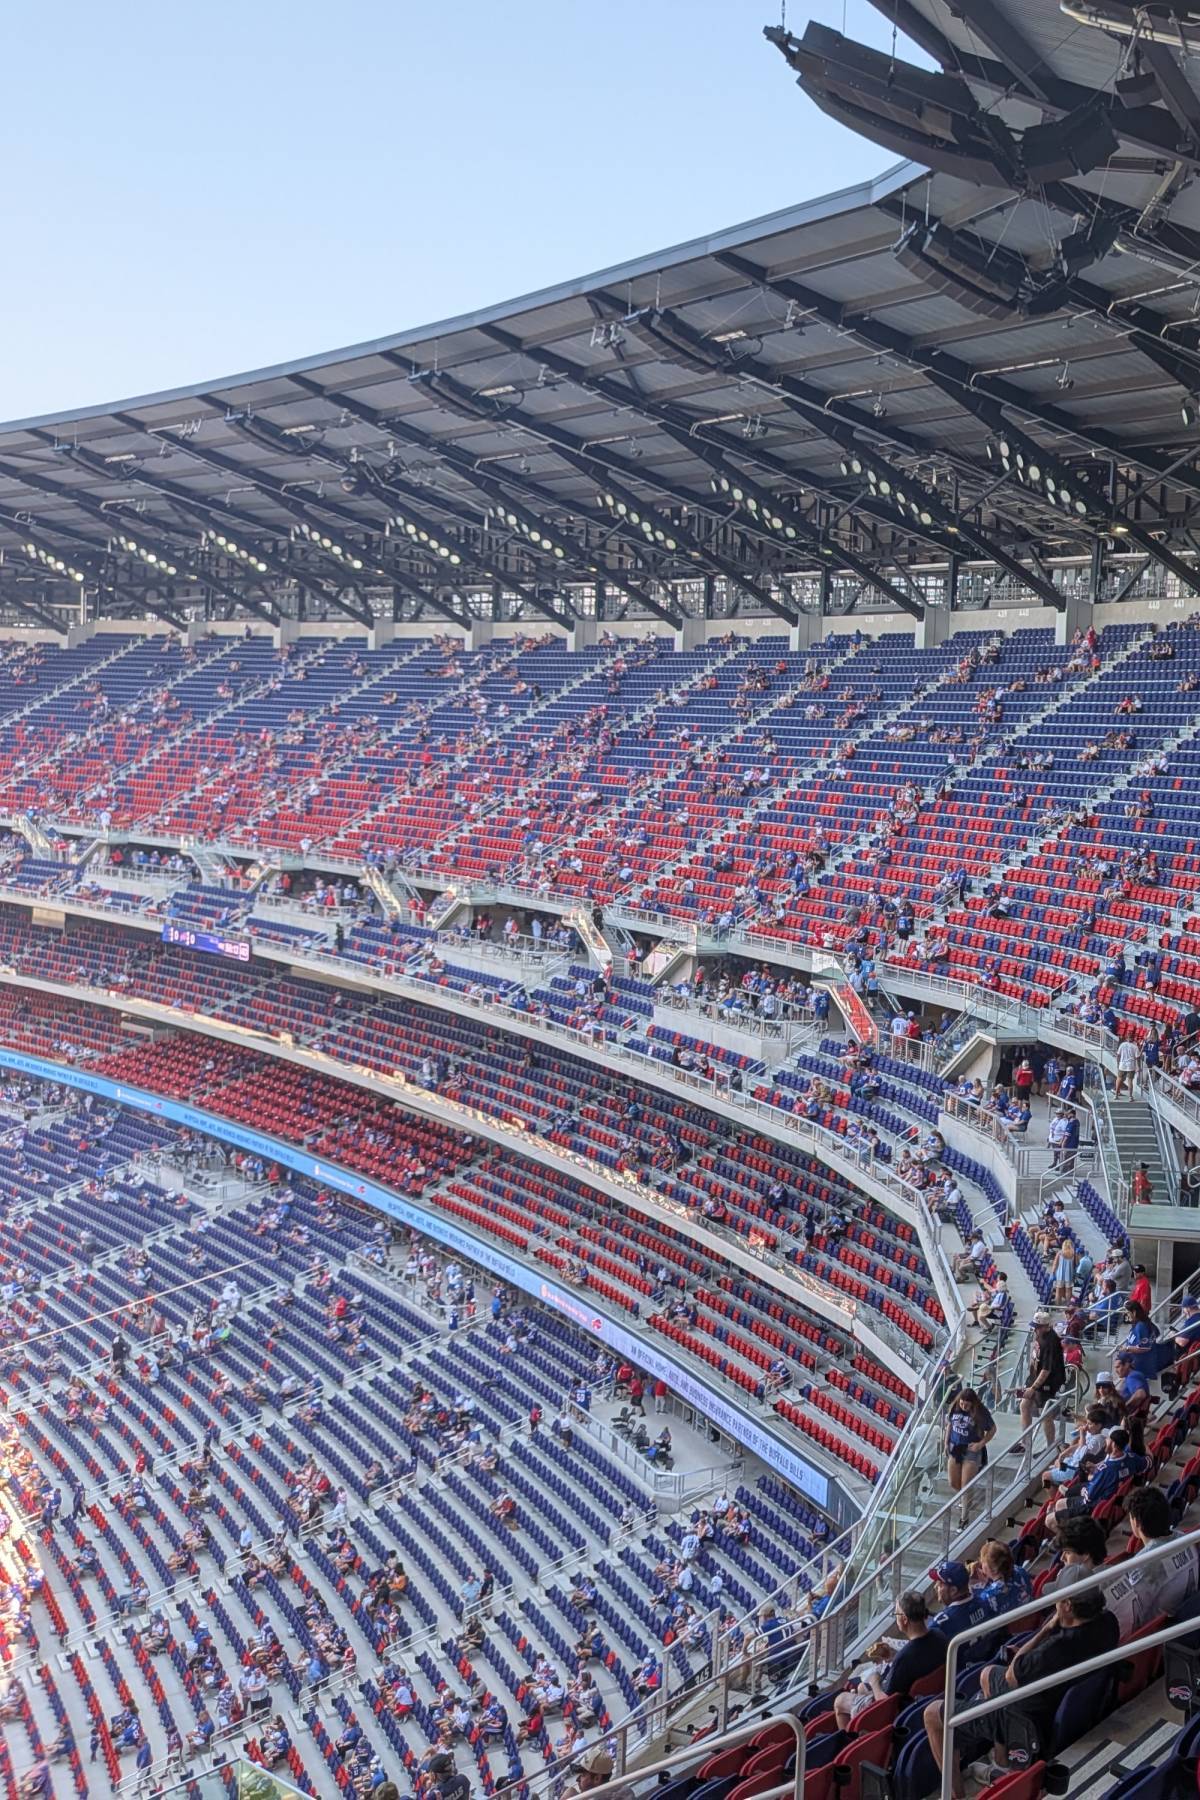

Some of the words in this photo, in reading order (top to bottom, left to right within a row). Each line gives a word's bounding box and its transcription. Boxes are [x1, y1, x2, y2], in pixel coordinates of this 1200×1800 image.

[732, 1418, 752, 1440] PARTNER
[768, 1446, 789, 1470] BUFFALO
[789, 1462, 804, 1480] BILLS
[1172, 1550, 1189, 1569] COOK
[1111, 1580, 1129, 1600] COOK
